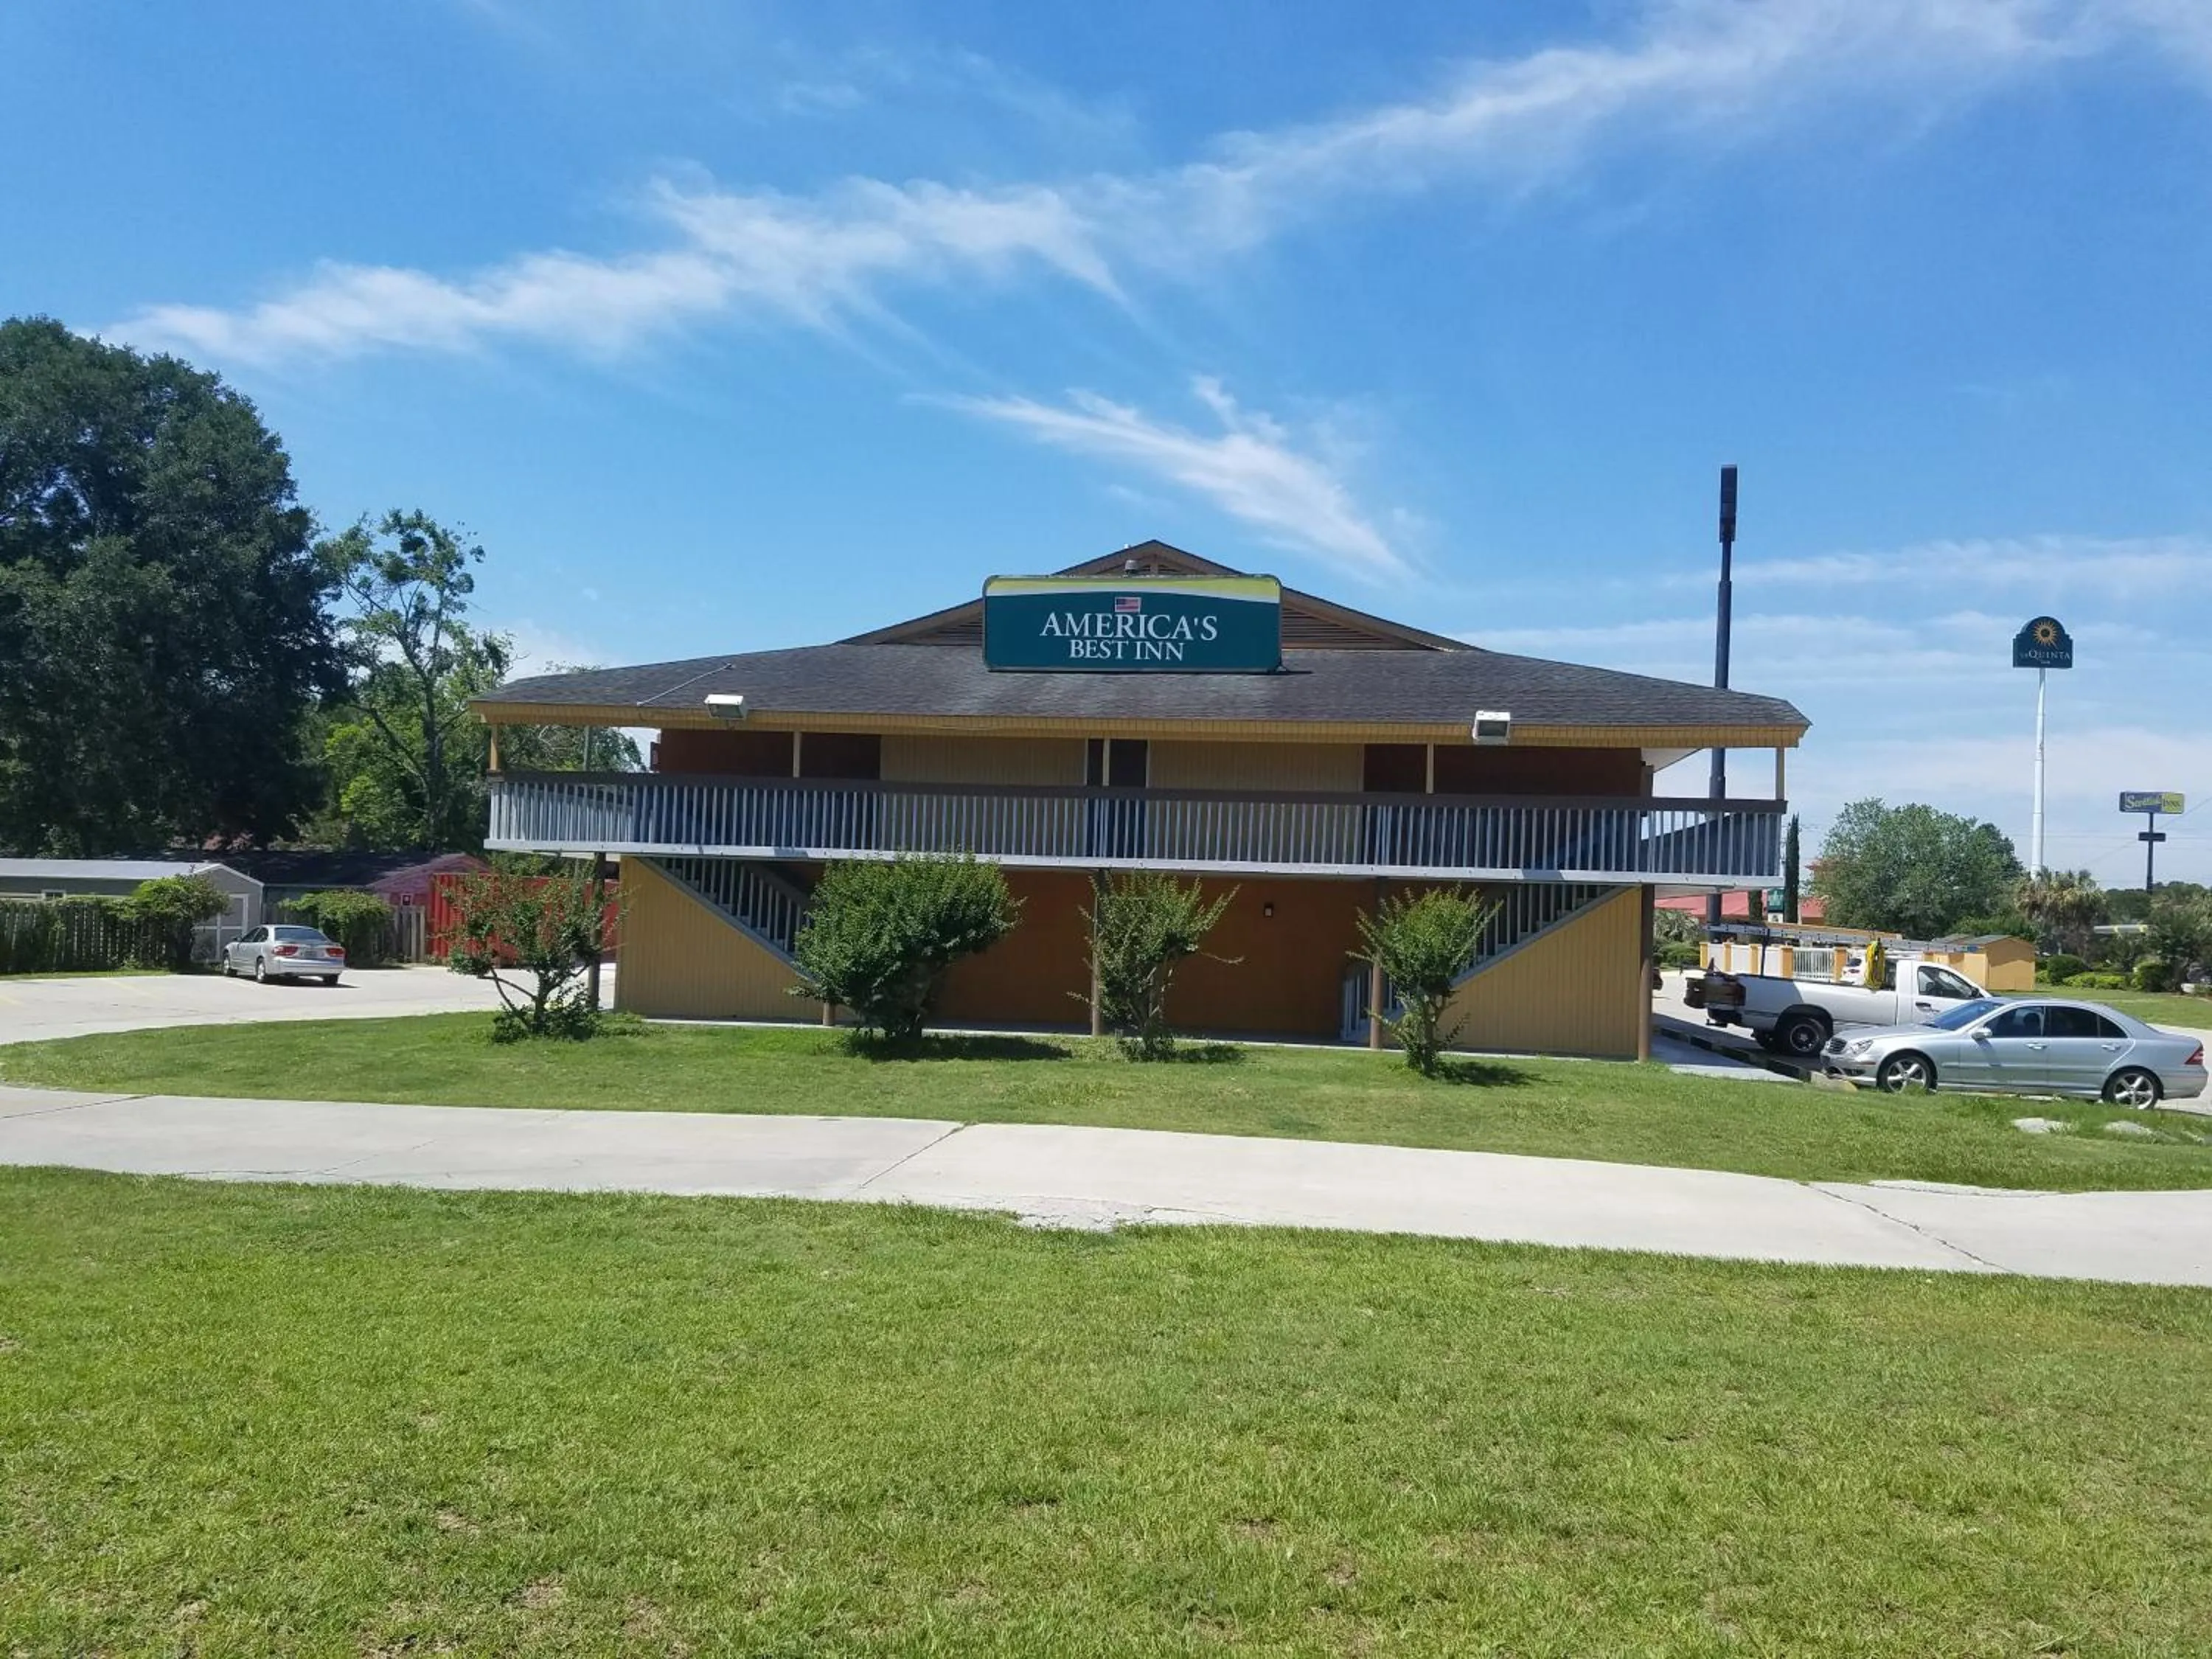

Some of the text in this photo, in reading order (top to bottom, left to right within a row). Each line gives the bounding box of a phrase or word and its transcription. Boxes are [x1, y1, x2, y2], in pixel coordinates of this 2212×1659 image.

[1039, 612, 1217, 641] AMERICA'S
[1069, 639, 1185, 661] BEST INN
